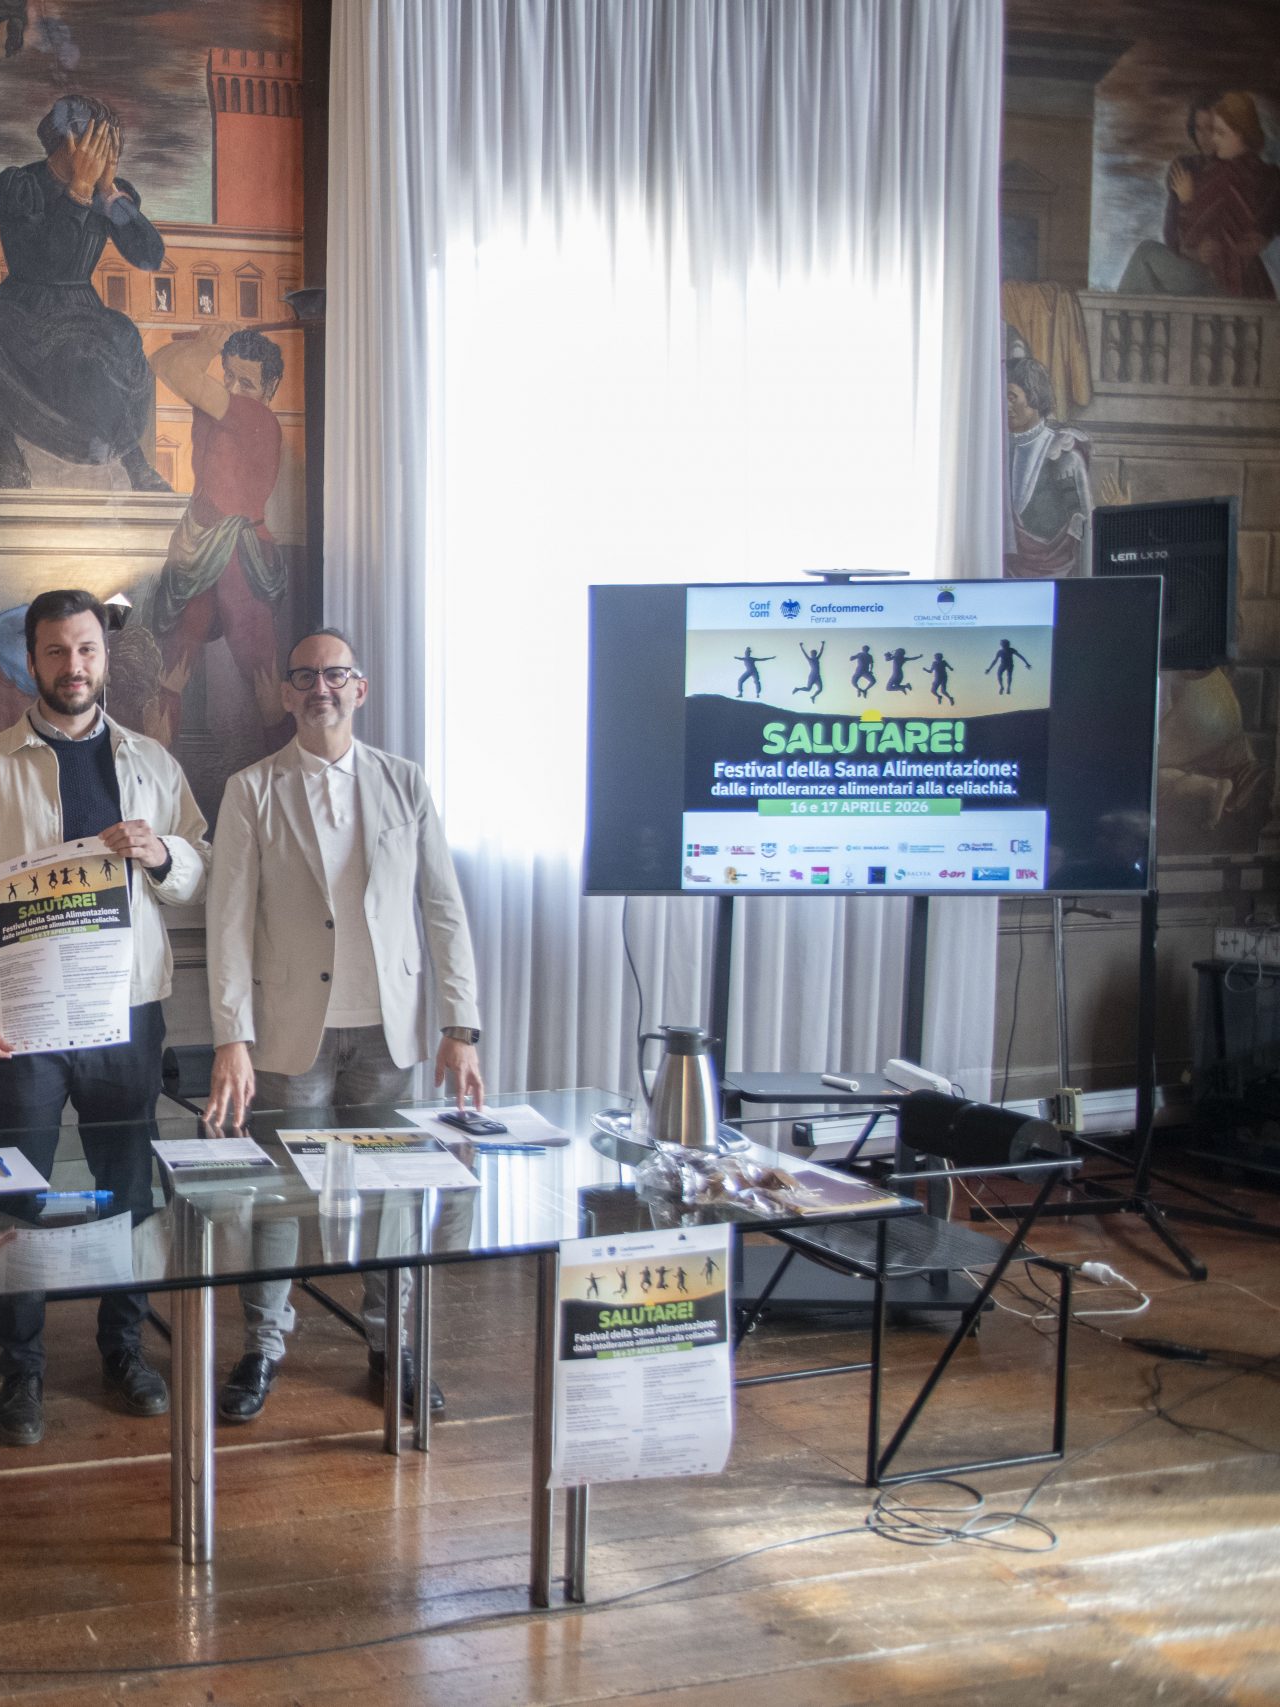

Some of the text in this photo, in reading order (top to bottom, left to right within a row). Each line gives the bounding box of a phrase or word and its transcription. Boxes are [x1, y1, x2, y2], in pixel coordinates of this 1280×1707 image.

[1111, 551, 1168, 561] LEM LX70
[749, 600, 771, 610] Conf
[811, 603, 884, 613] Confcommercio
[762, 721, 965, 755] SALUTARE!
[713, 760, 1018, 778] Festival della Sana Alimentazione:
[711, 781, 1017, 796] dalle intolleranze alimentari alla celiachia.
[790, 801, 928, 813] 16 e 17 APRILE 2026
[18, 893, 97, 920] SALUTARE!
[2, 908, 119, 934] Festival della Sana Alimentazione:
[2, 933, 15, 941] dalle
[16, 925, 48, 936] intolleranze
[49, 919, 79, 929] alimentari
[599, 1301, 693, 1328] SALUTARE!
[574, 1319, 716, 1342] Festival della Sana Alimentazione:
[592, 1340, 634, 1350] intolleranze
[671, 1334, 684, 1342] alla
